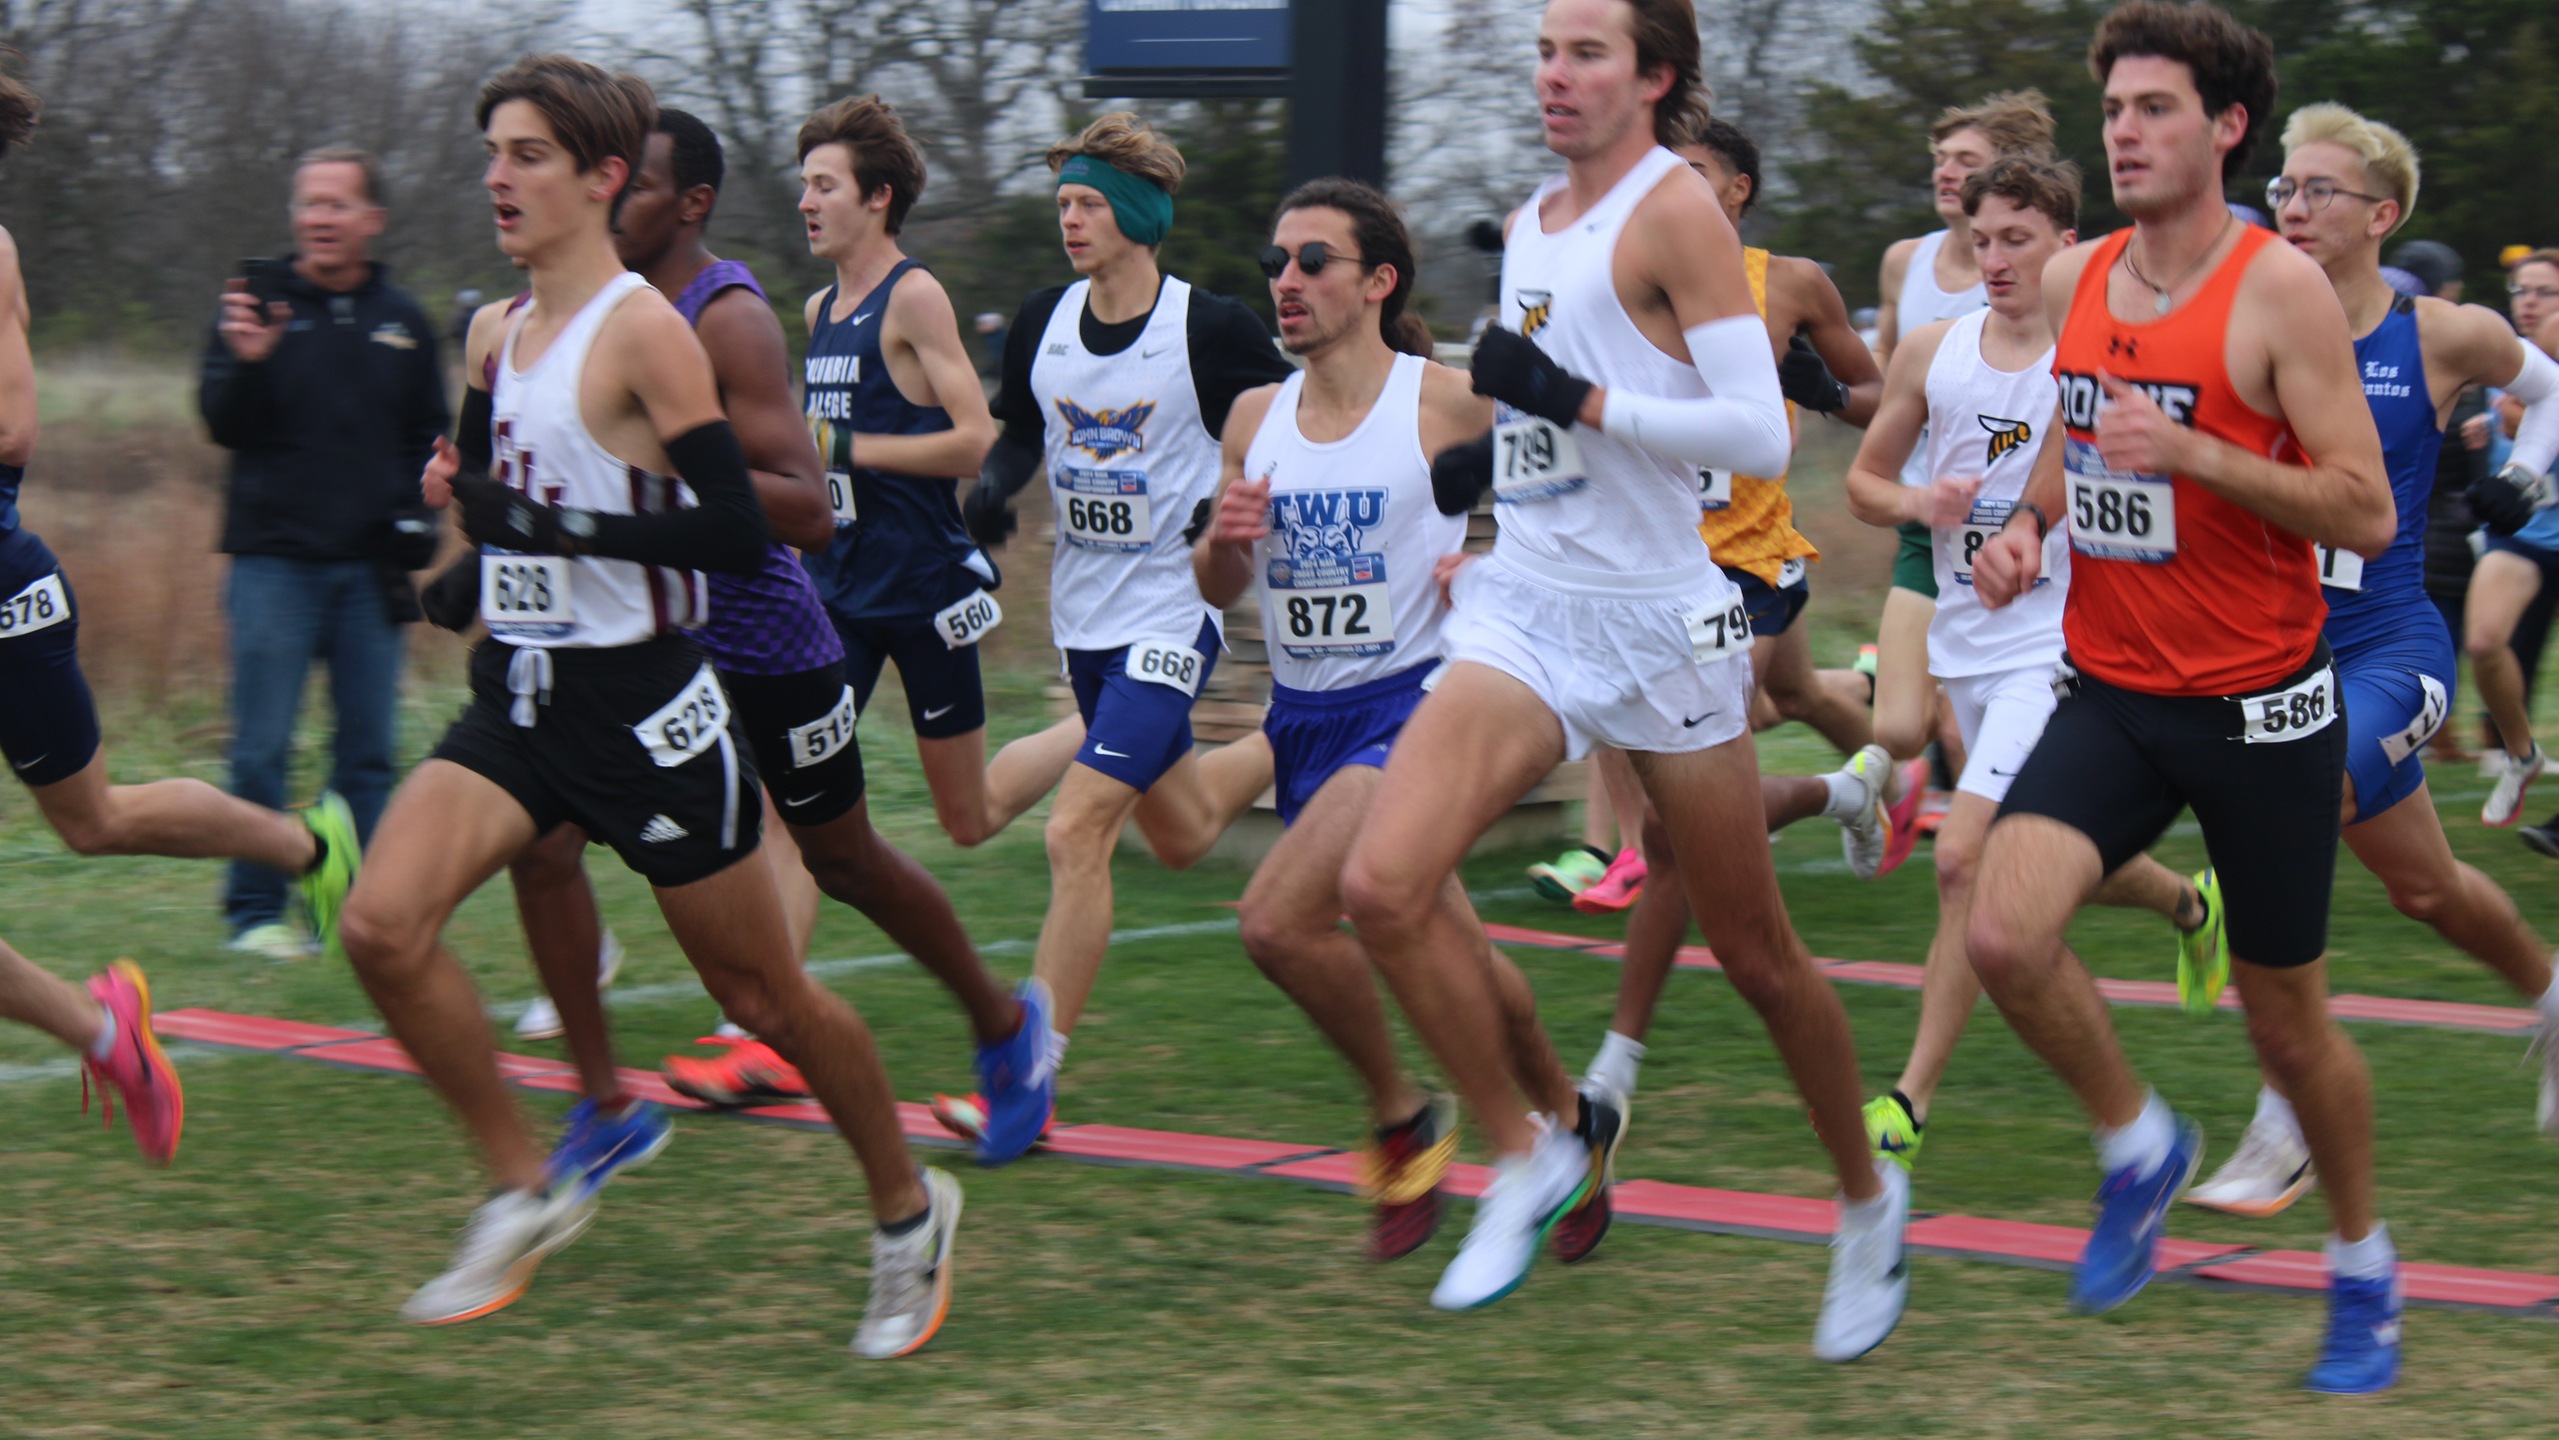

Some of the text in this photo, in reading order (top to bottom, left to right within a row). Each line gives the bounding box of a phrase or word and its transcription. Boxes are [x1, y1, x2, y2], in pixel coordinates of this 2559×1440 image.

[2361, 382, 2411, 397] antos
[2365, 361, 2399, 378] Los
[1072, 427, 1141, 450] JOHN BROWN
[1069, 497, 1133, 535] 668
[2075, 481, 2153, 536] 586
[0, 588, 53, 630] 678
[947, 598, 994, 640] 560
[1287, 593, 1371, 637] 872
[1141, 648, 1195, 685] 668
[2262, 684, 2325, 734] 586
